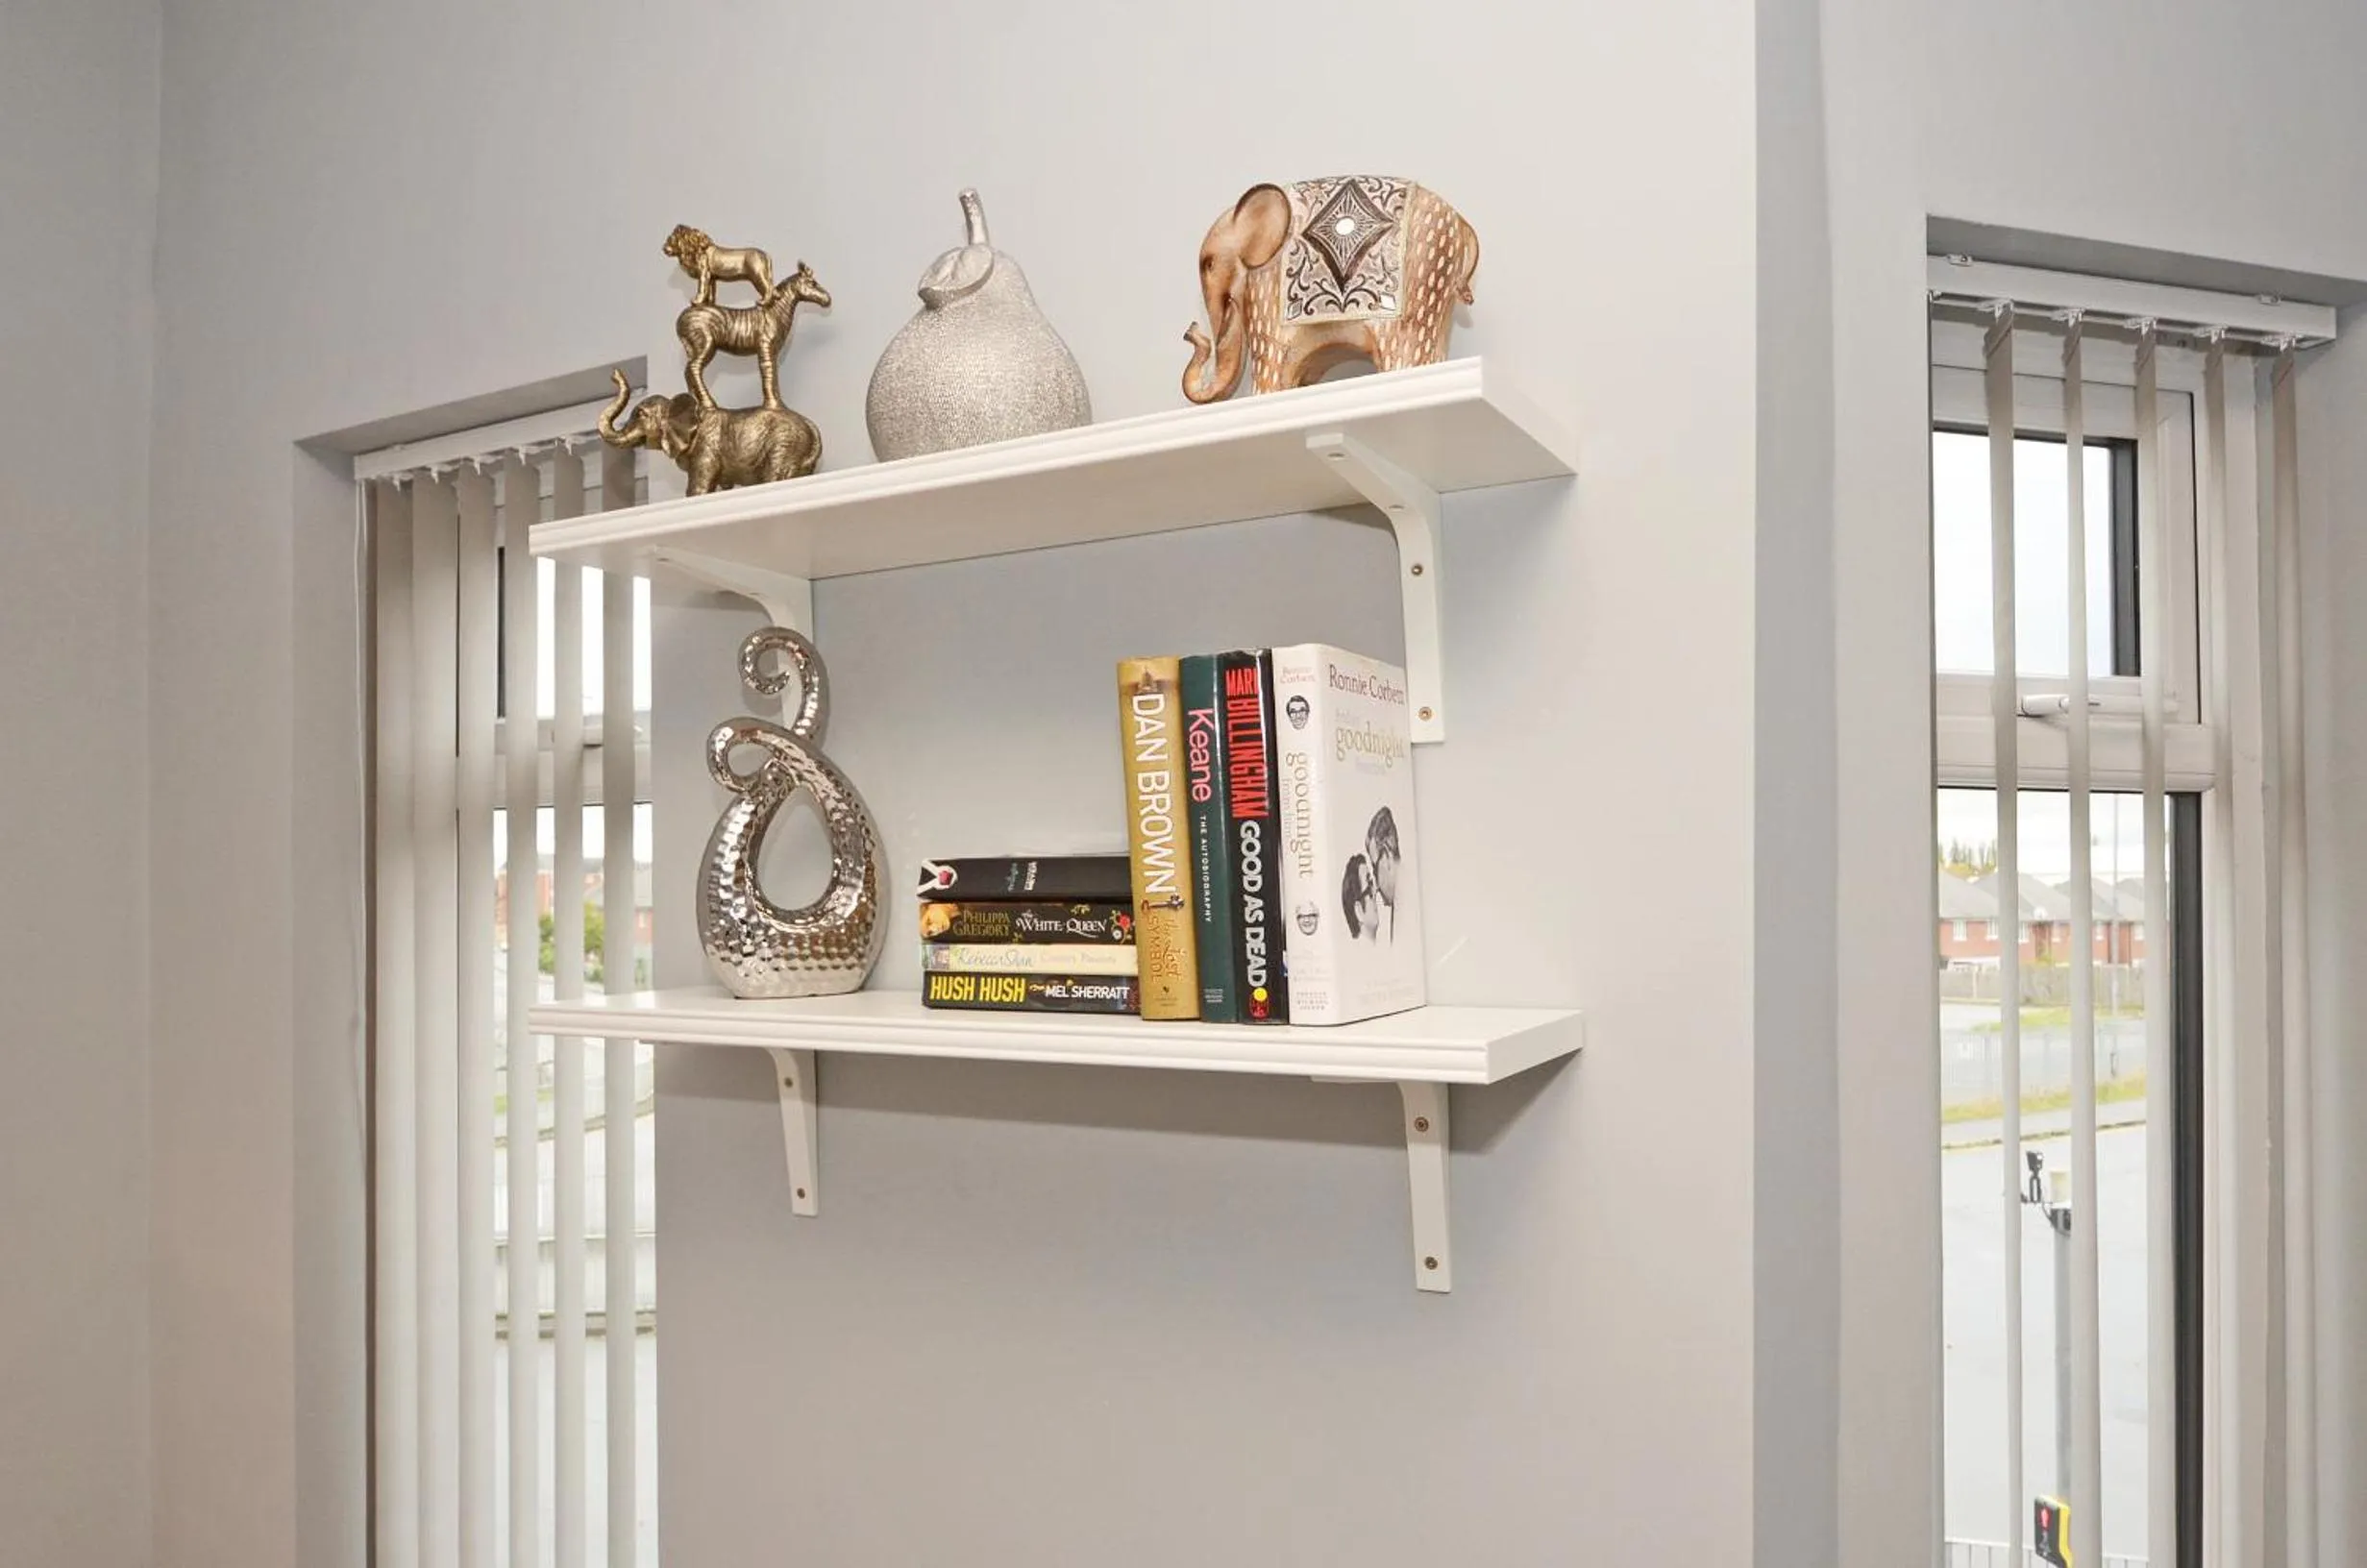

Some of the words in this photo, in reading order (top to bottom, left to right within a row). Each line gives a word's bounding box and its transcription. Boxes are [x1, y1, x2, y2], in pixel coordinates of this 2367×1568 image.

[1329, 664, 1368, 696] Ronnie
[1132, 694, 1169, 762] DAN
[1188, 708, 1215, 801] Keane
[1227, 698, 1269, 818] BILLINGHAM
[1137, 771, 1176, 894] BROWN
[1199, 815, 1208, 834] THE
[1200, 838, 1212, 923] AUTOBIOGRAPHY
[1240, 821, 1263, 893] GOOD
[952, 920, 1011, 936] GREGORY
[963, 910, 1011, 923] PHILIPPA
[1244, 894, 1265, 923] AS
[1245, 926, 1267, 988] DEAD
[929, 975, 974, 1001] HUSH
[979, 976, 1025, 1003] HUSH
[1045, 985, 1069, 998] MEL
[1071, 986, 1130, 999] SHERRATT
